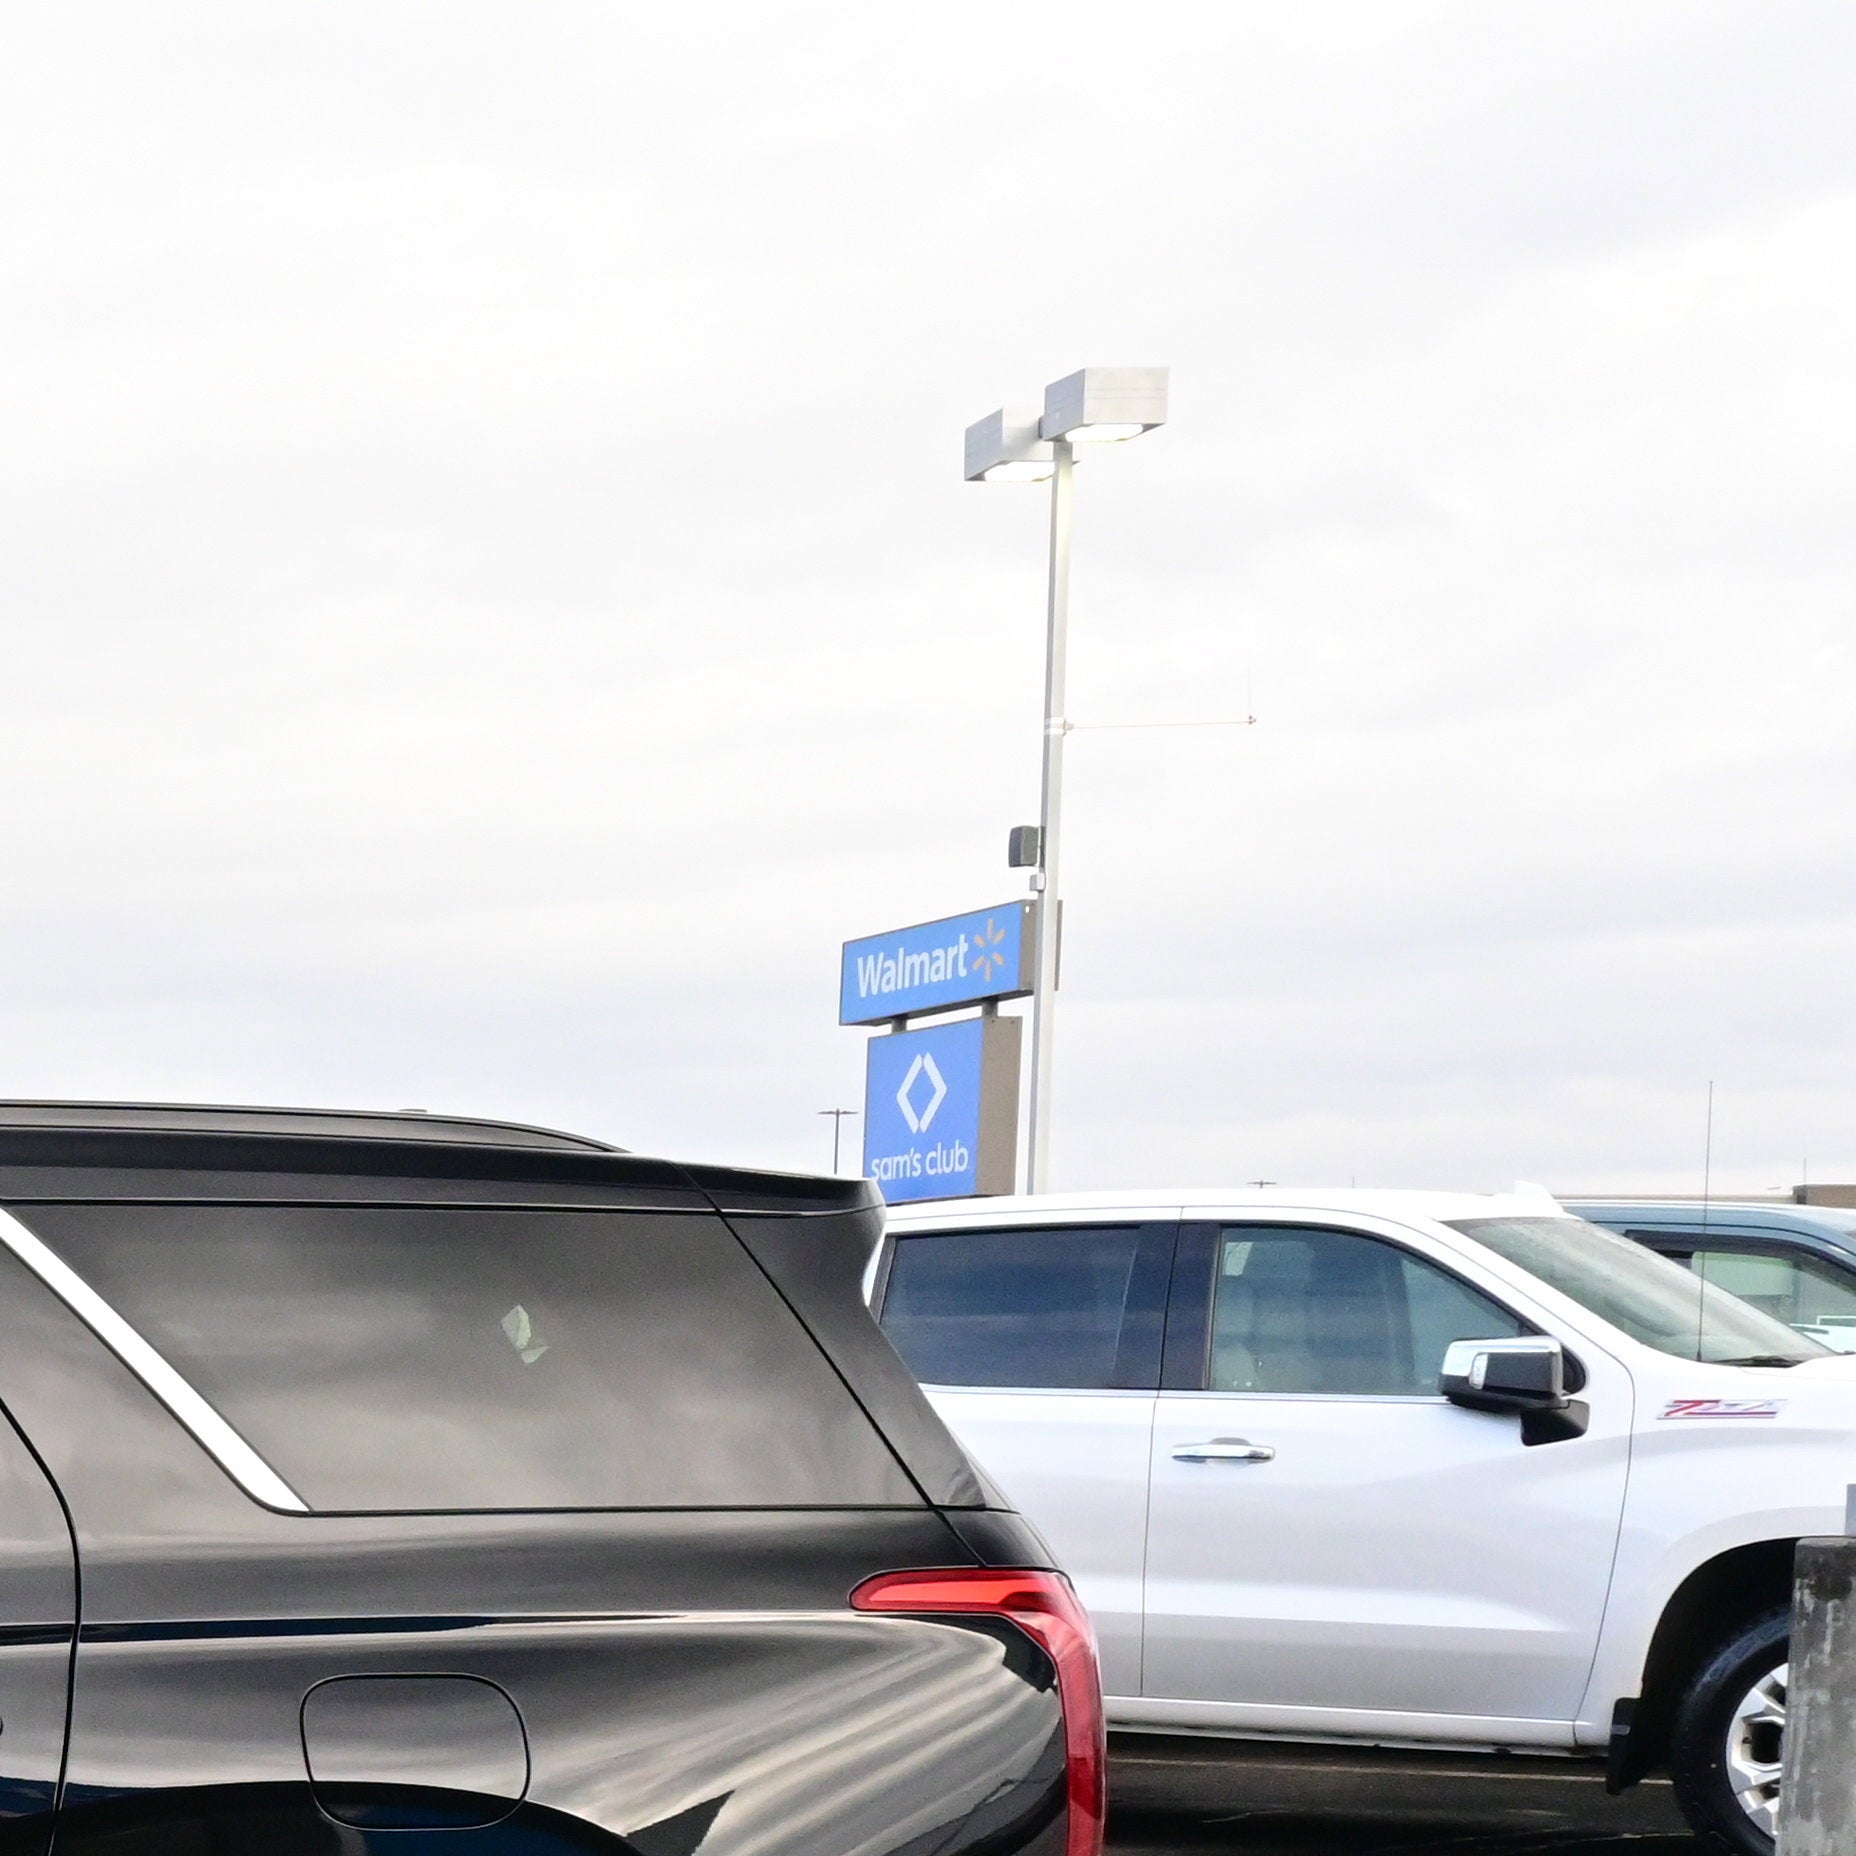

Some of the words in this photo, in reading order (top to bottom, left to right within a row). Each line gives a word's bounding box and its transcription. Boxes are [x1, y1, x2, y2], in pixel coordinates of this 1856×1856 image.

[857, 934, 968, 998] Walmart
[871, 1147, 922, 1181] sam's
[925, 1139, 969, 1176] club
